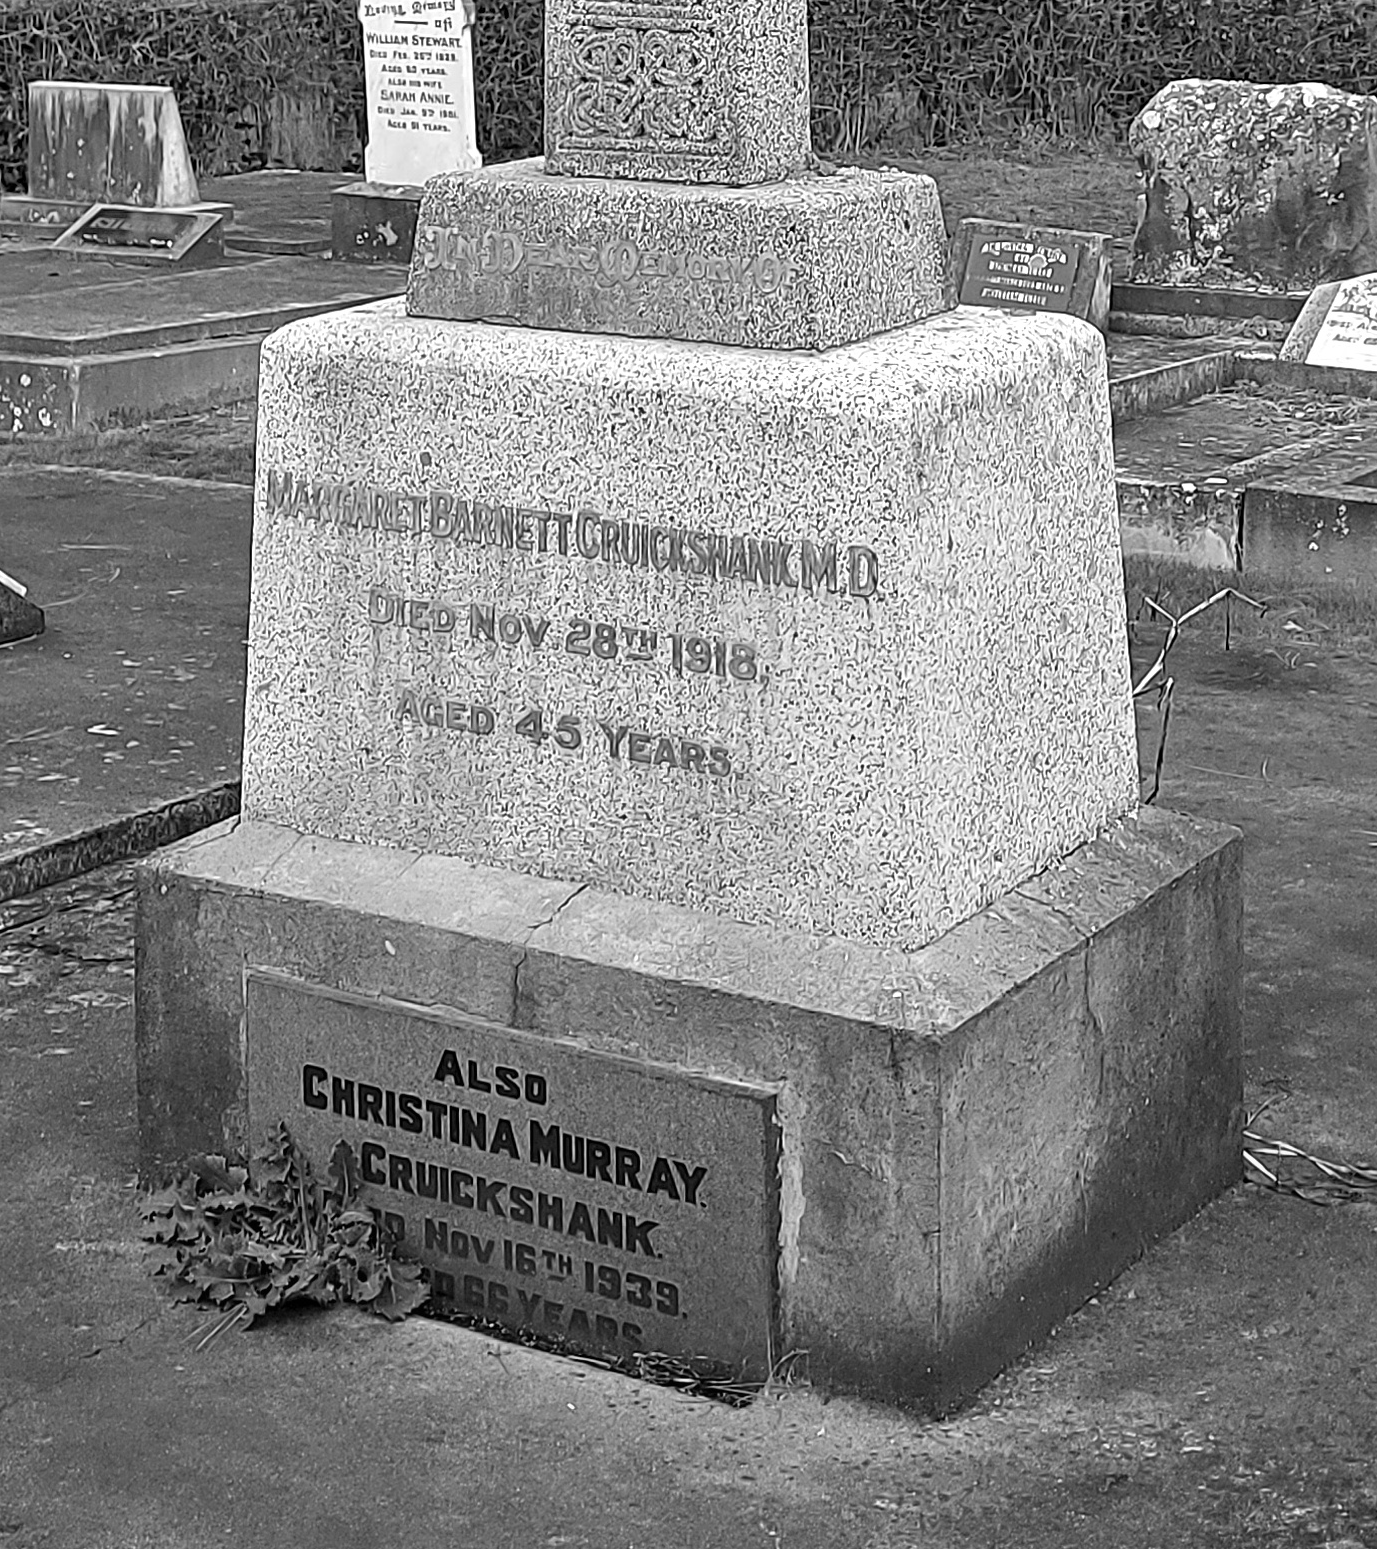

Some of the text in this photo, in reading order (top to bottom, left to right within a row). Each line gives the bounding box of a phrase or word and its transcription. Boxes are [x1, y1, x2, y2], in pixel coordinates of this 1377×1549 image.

[366, 32, 409, 45] WILLIAM
[380, 89, 416, 103] SARAH
[266, 468, 427, 536] MARGARET
[429, 489, 573, 555] BARNETT
[575, 509, 798, 588] CRUICKSHANK
[368, 588, 456, 634] DIED
[469, 603, 551, 648] NOV
[396, 690, 495, 736] AGED
[515, 709, 582, 750] 45
[434, 1048, 548, 1106] ALSO
[302, 1063, 710, 1209] CHRISTINA MURRAY.
[360, 1141, 664, 1260] CRUICKSHANK.
[424, 1217, 496, 1265] NOV
